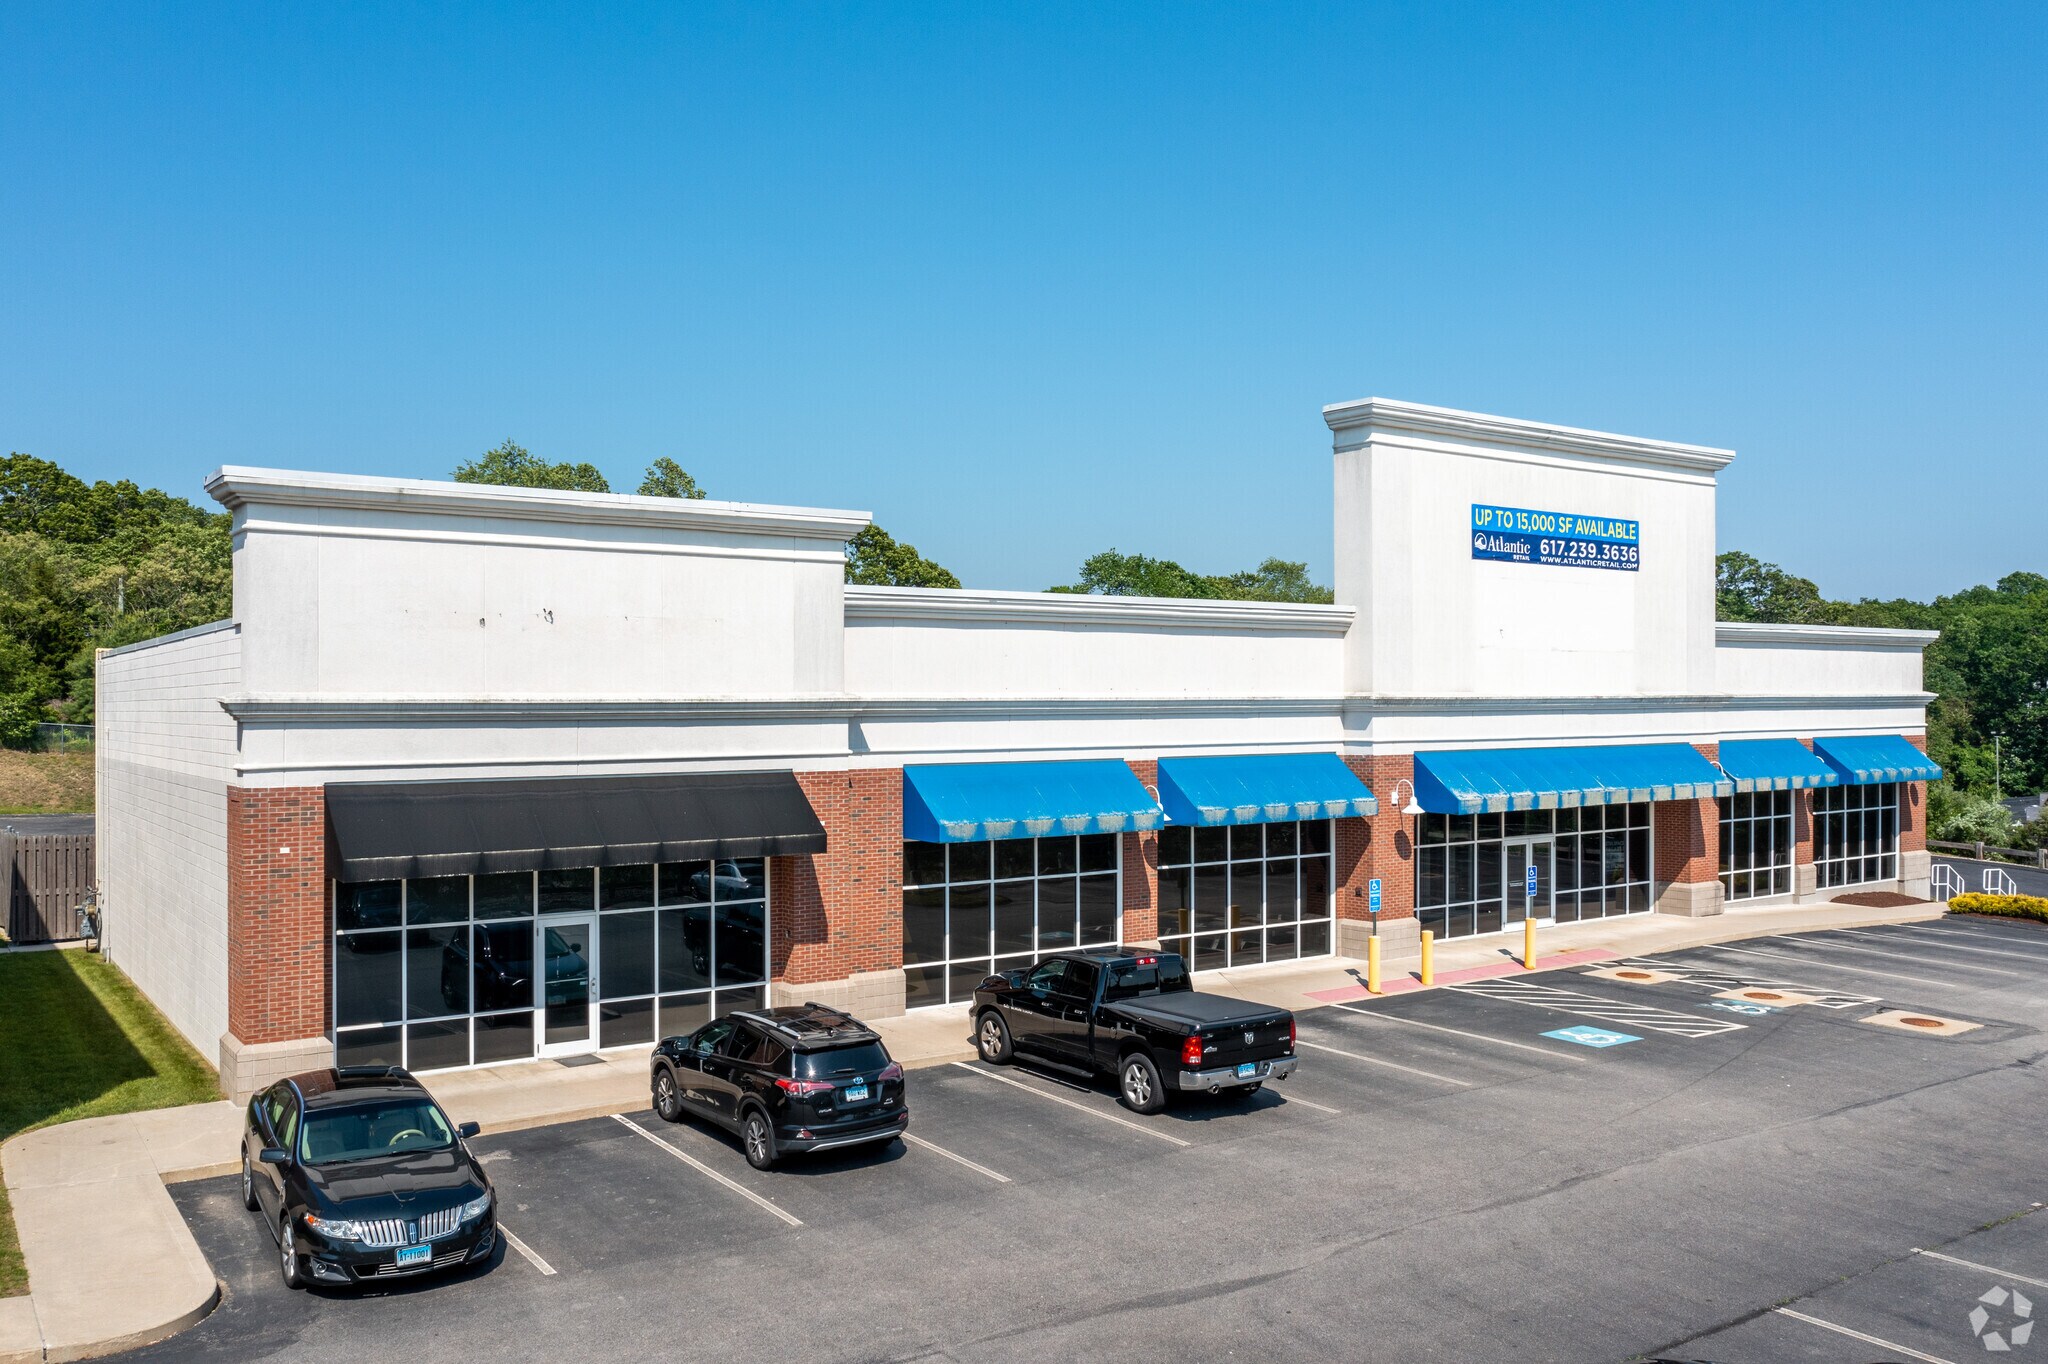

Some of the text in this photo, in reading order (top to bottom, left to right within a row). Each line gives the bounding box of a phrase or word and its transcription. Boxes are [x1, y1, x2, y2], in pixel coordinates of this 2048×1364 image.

[1475, 508, 1637, 540] UP TO 15,000 SF AVAILABLE
[1487, 535, 1531, 554] Atlantic
[1540, 539, 1637, 562] 617.239.3636
[1540, 556, 1638, 569] WWW.ATLANTICRETAIL.COM
